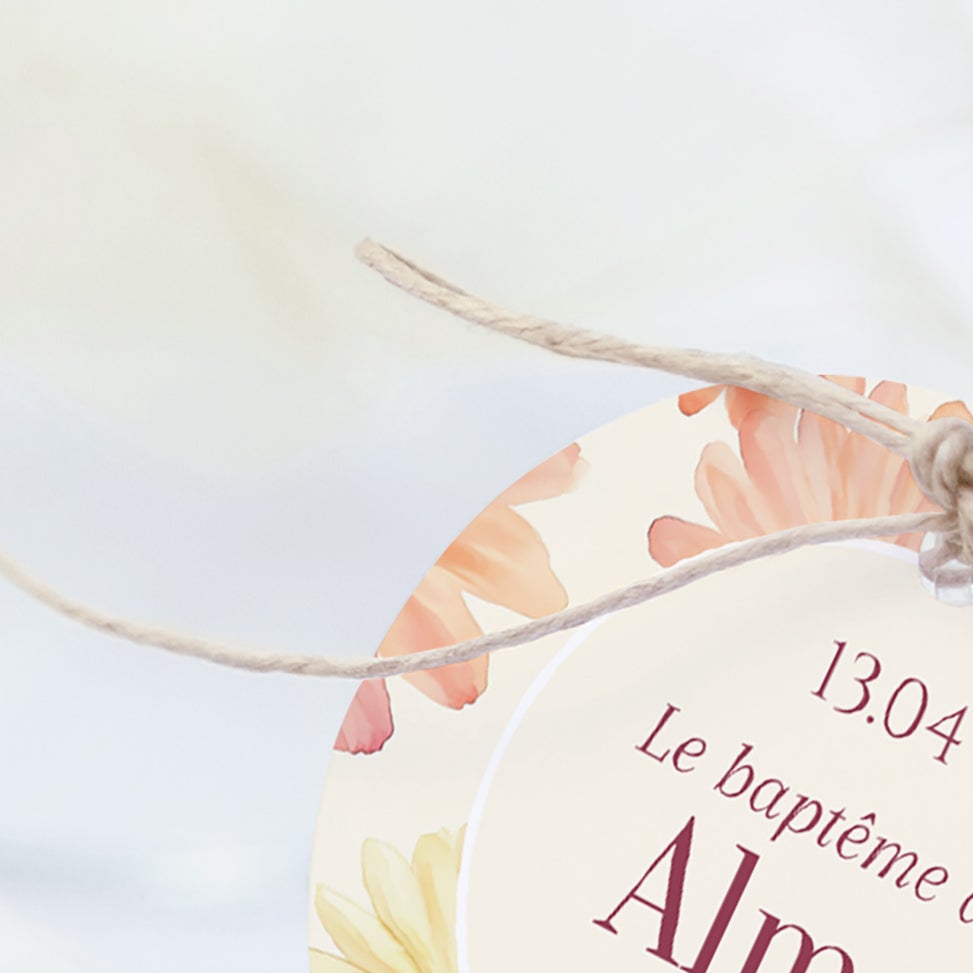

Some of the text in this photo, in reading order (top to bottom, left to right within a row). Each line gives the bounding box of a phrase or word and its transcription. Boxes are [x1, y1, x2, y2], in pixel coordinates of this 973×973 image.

[810, 640, 968, 765] 13.04
[635, 703, 707, 773] Le
[713, 742, 949, 902] baptême
